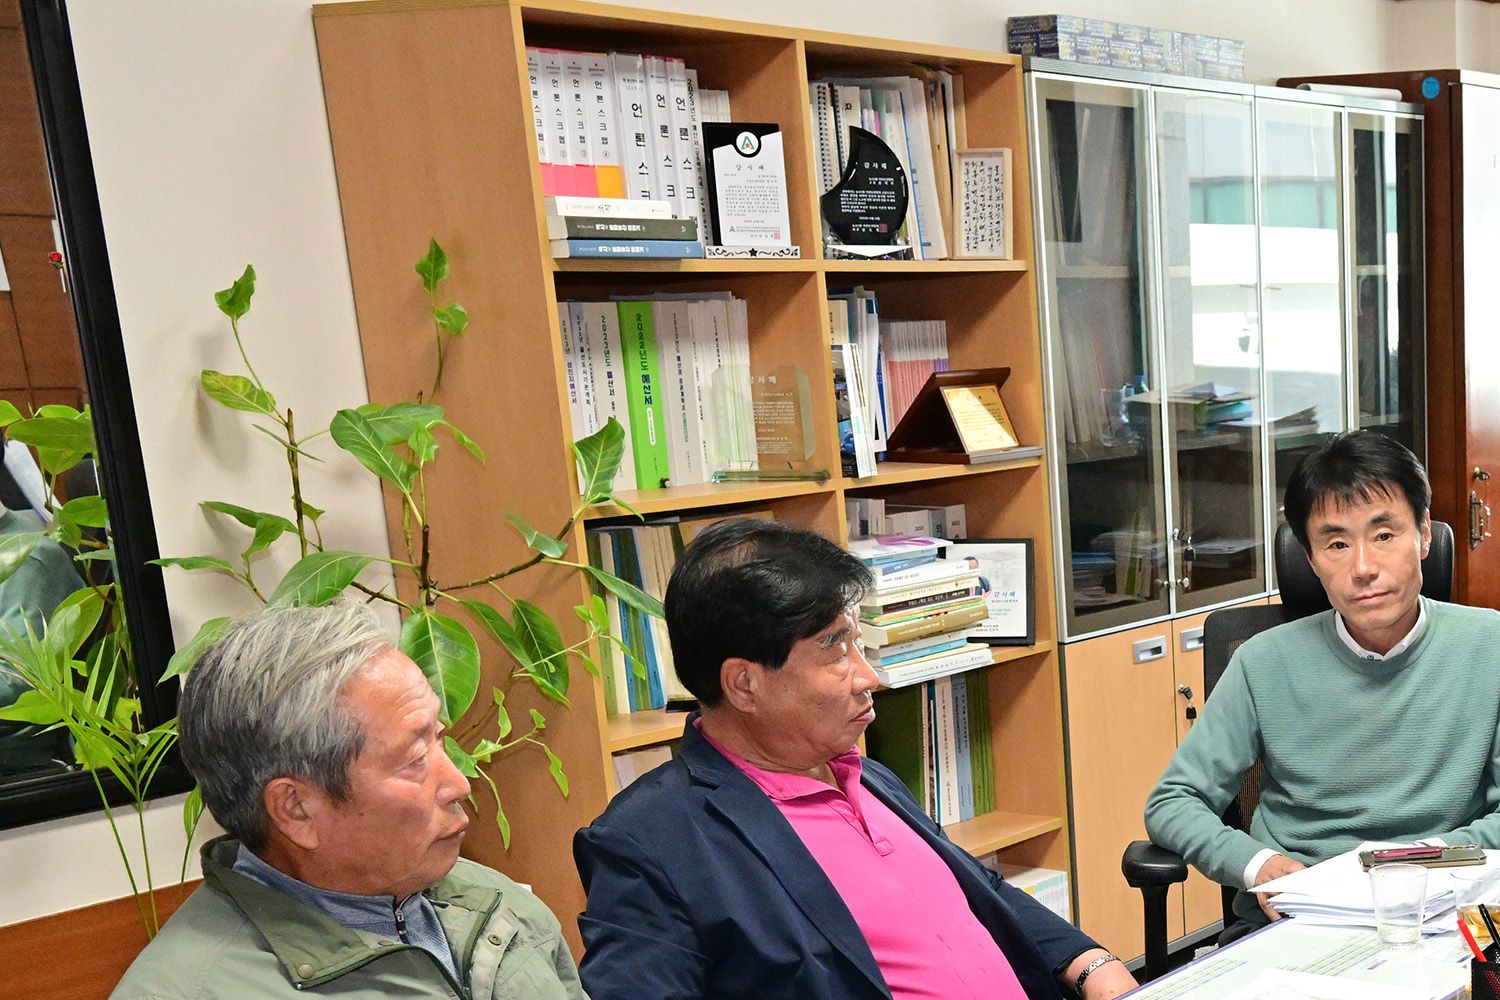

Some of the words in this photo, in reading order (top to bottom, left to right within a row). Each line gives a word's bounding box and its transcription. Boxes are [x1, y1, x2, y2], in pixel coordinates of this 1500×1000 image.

[551, 78, 566, 145] 언론스크랩
[572, 78, 586, 144] 언론스크랩
[594, 80, 609, 145] 언론스크랩
[601, 315, 612, 367] 2023년도
[607, 371, 616, 397] 예산서
[635, 313, 649, 372] 2022년도
[641, 374, 653, 405] 예산서
